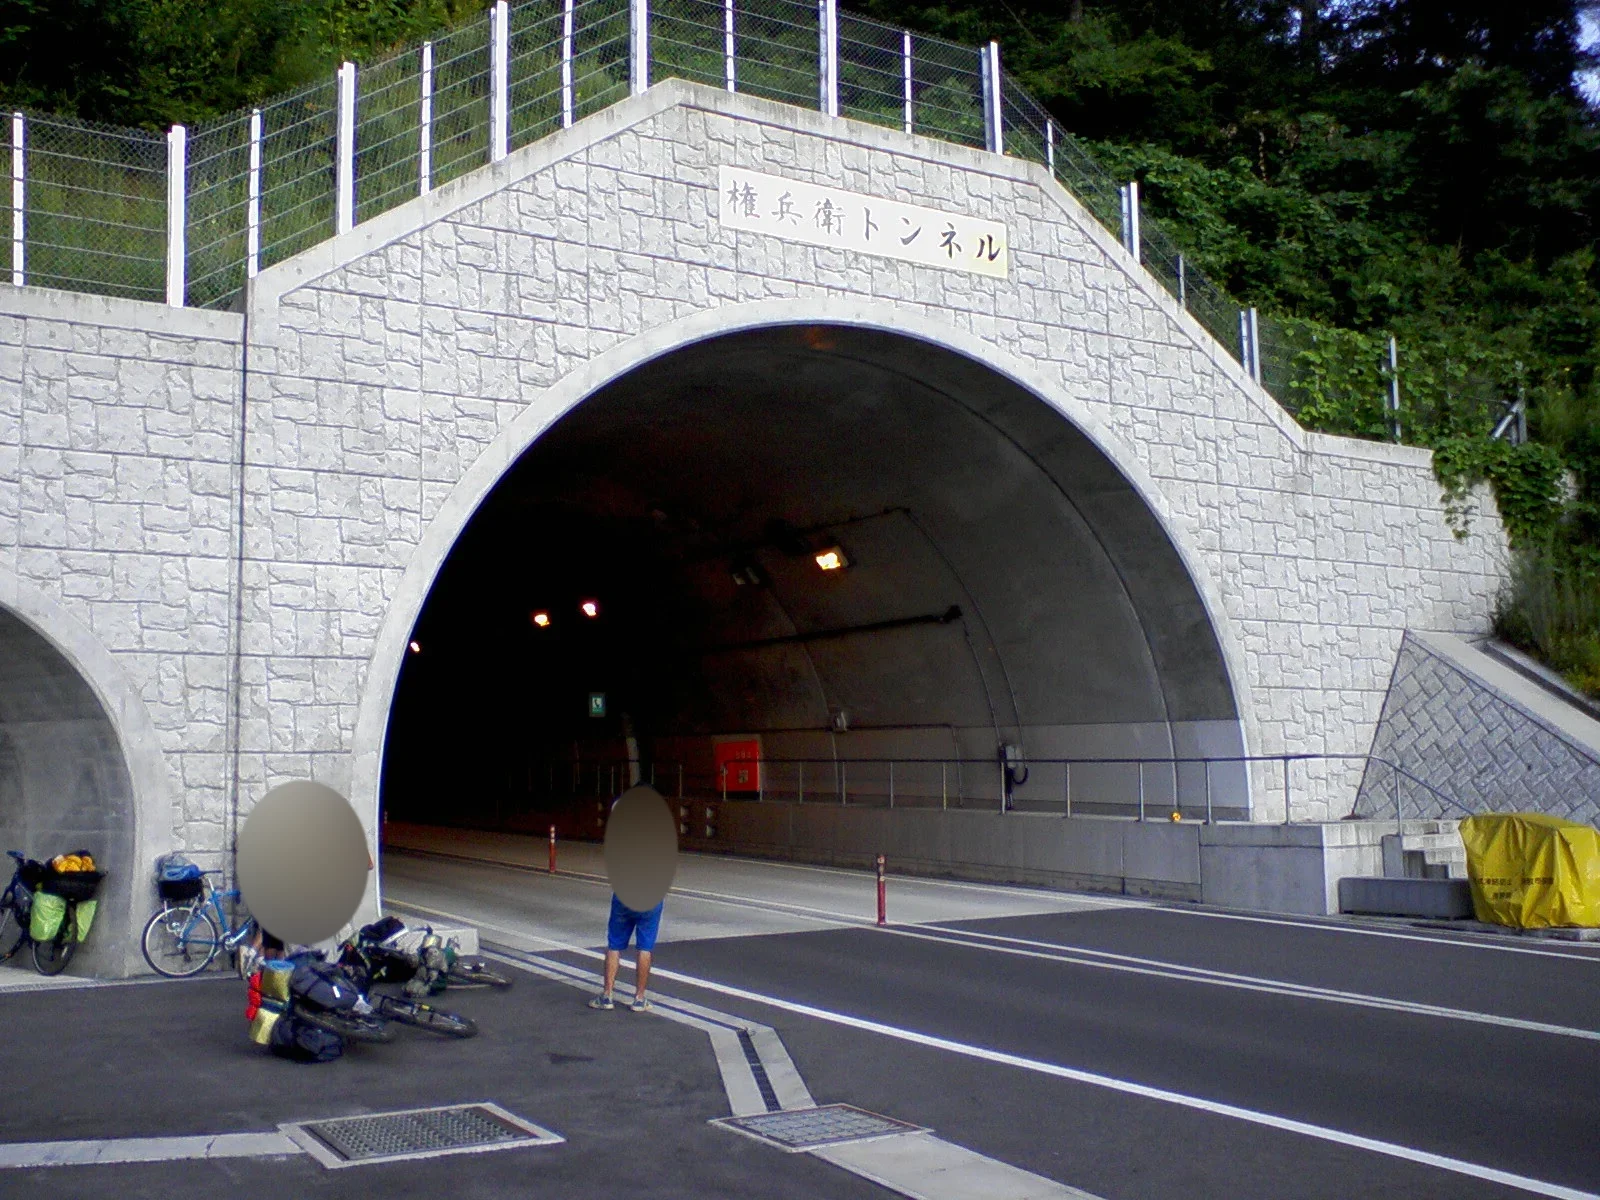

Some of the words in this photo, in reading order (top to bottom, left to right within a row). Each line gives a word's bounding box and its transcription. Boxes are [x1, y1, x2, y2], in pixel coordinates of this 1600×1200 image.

[727, 180, 1000, 261] 権兵衛トンネル
